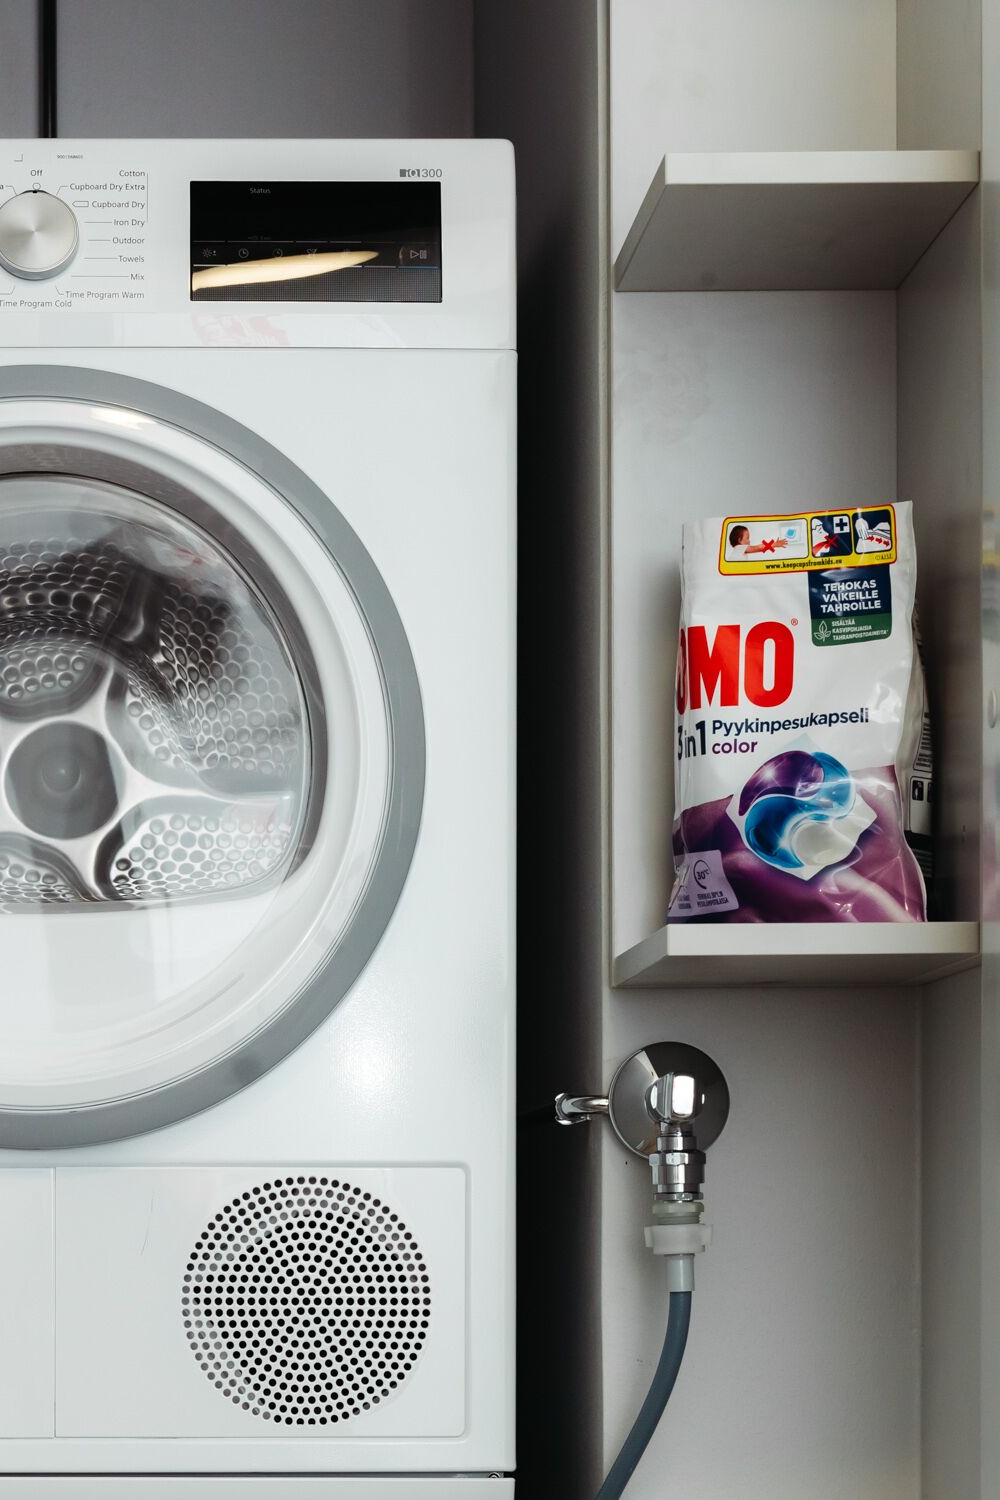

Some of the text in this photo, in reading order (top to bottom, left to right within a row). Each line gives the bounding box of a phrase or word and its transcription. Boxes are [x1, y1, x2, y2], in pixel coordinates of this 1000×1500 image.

[30, 169, 43, 177] Off
[118, 169, 146, 177] Cotton
[69, 182, 146, 192] Cupboard Dry Extra
[249, 187, 271, 195] Status
[91, 200, 146, 210] Cupboard Dry
[113, 218, 145, 228] Iron Dry
[112, 236, 145, 245] Outdoor
[118, 255, 145, 263] Towels
[130, 273, 145, 281] Mix
[65, 290, 145, 301] Time Program Warm
[19, 299, 53, 310] Program
[54, 299, 72, 308] Cold
[823, 579, 877, 592] TEHOKAS
[822, 589, 879, 603] VAIKEILLE
[820, 600, 882, 613] TAHROILLE
[831, 618, 856, 627] SISÄLTÄÄ
[712, 707, 870, 737] Pyykinpesukapseli
[711, 737, 758, 755] color
